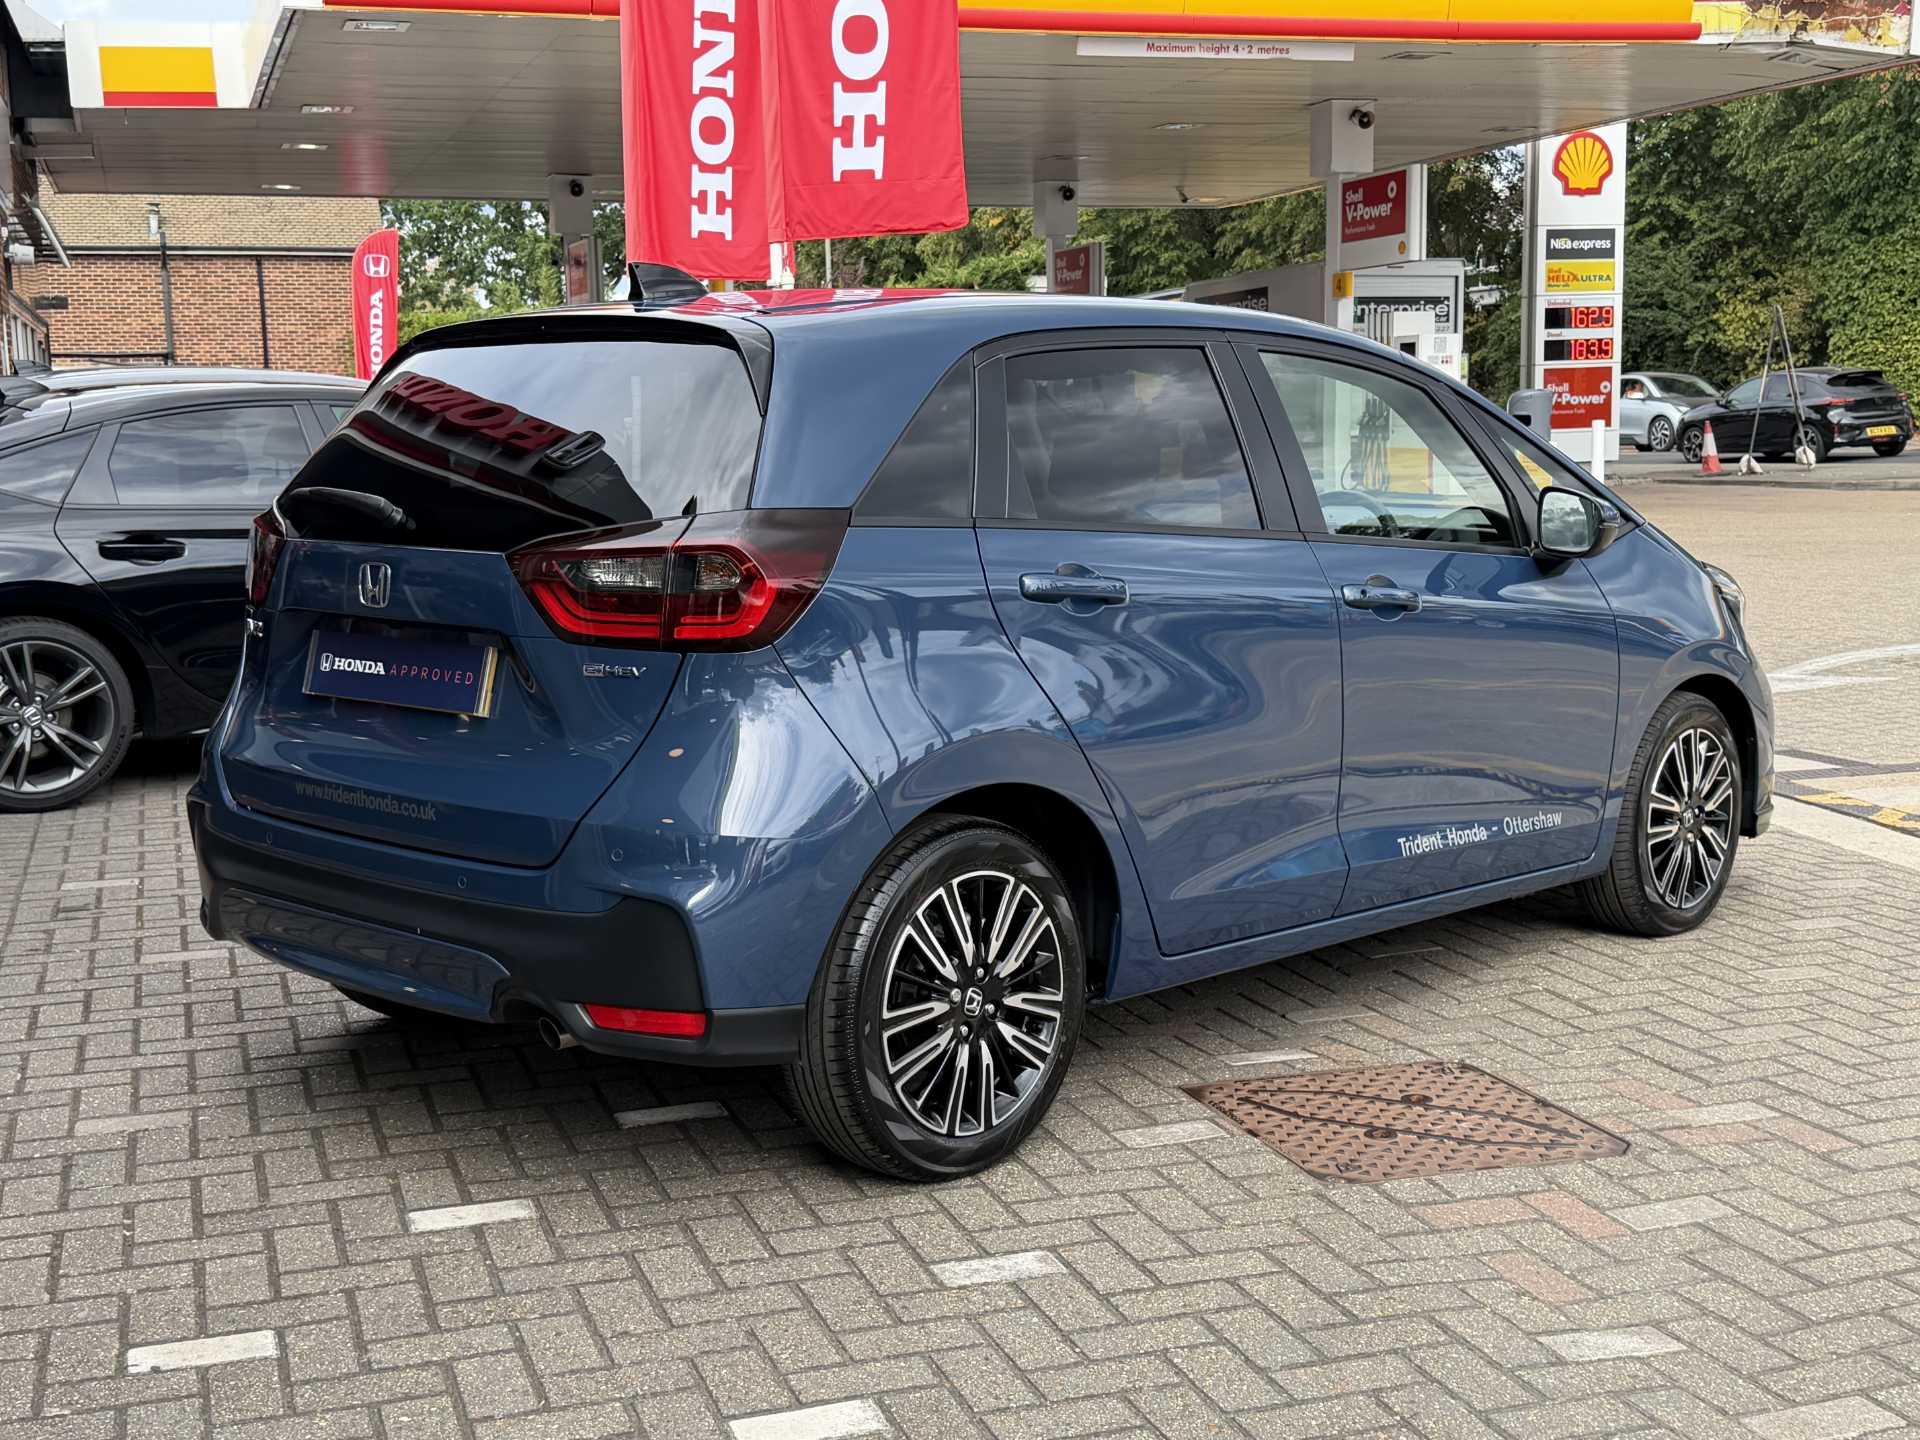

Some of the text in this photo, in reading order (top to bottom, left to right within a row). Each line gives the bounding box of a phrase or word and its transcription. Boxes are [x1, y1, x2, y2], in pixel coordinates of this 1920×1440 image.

[1146, 42, 1195, 53] Maximum
[1199, 43, 1231, 56] height
[1257, 45, 1290, 55] metres
[1345, 187, 1363, 204] Shell
[1345, 202, 1392, 223] V-Power
[1550, 238, 1612, 251] Nisa express
[1580, 274, 1612, 282] ULTRA
[1353, 300, 1449, 316] nterprise
[1570, 307, 1612, 328] 162.9
[1570, 338, 1612, 360] 183.9
[1547, 382, 1569, 393] Shell
[333, 656, 474, 685] HONDA APPROVED
[294, 781, 437, 821] www.tridenthonda.co.uk
[1397, 830, 1443, 857] Trident
[1447, 823, 1487, 847] Honda
[1503, 810, 1563, 836] Ottershaw
